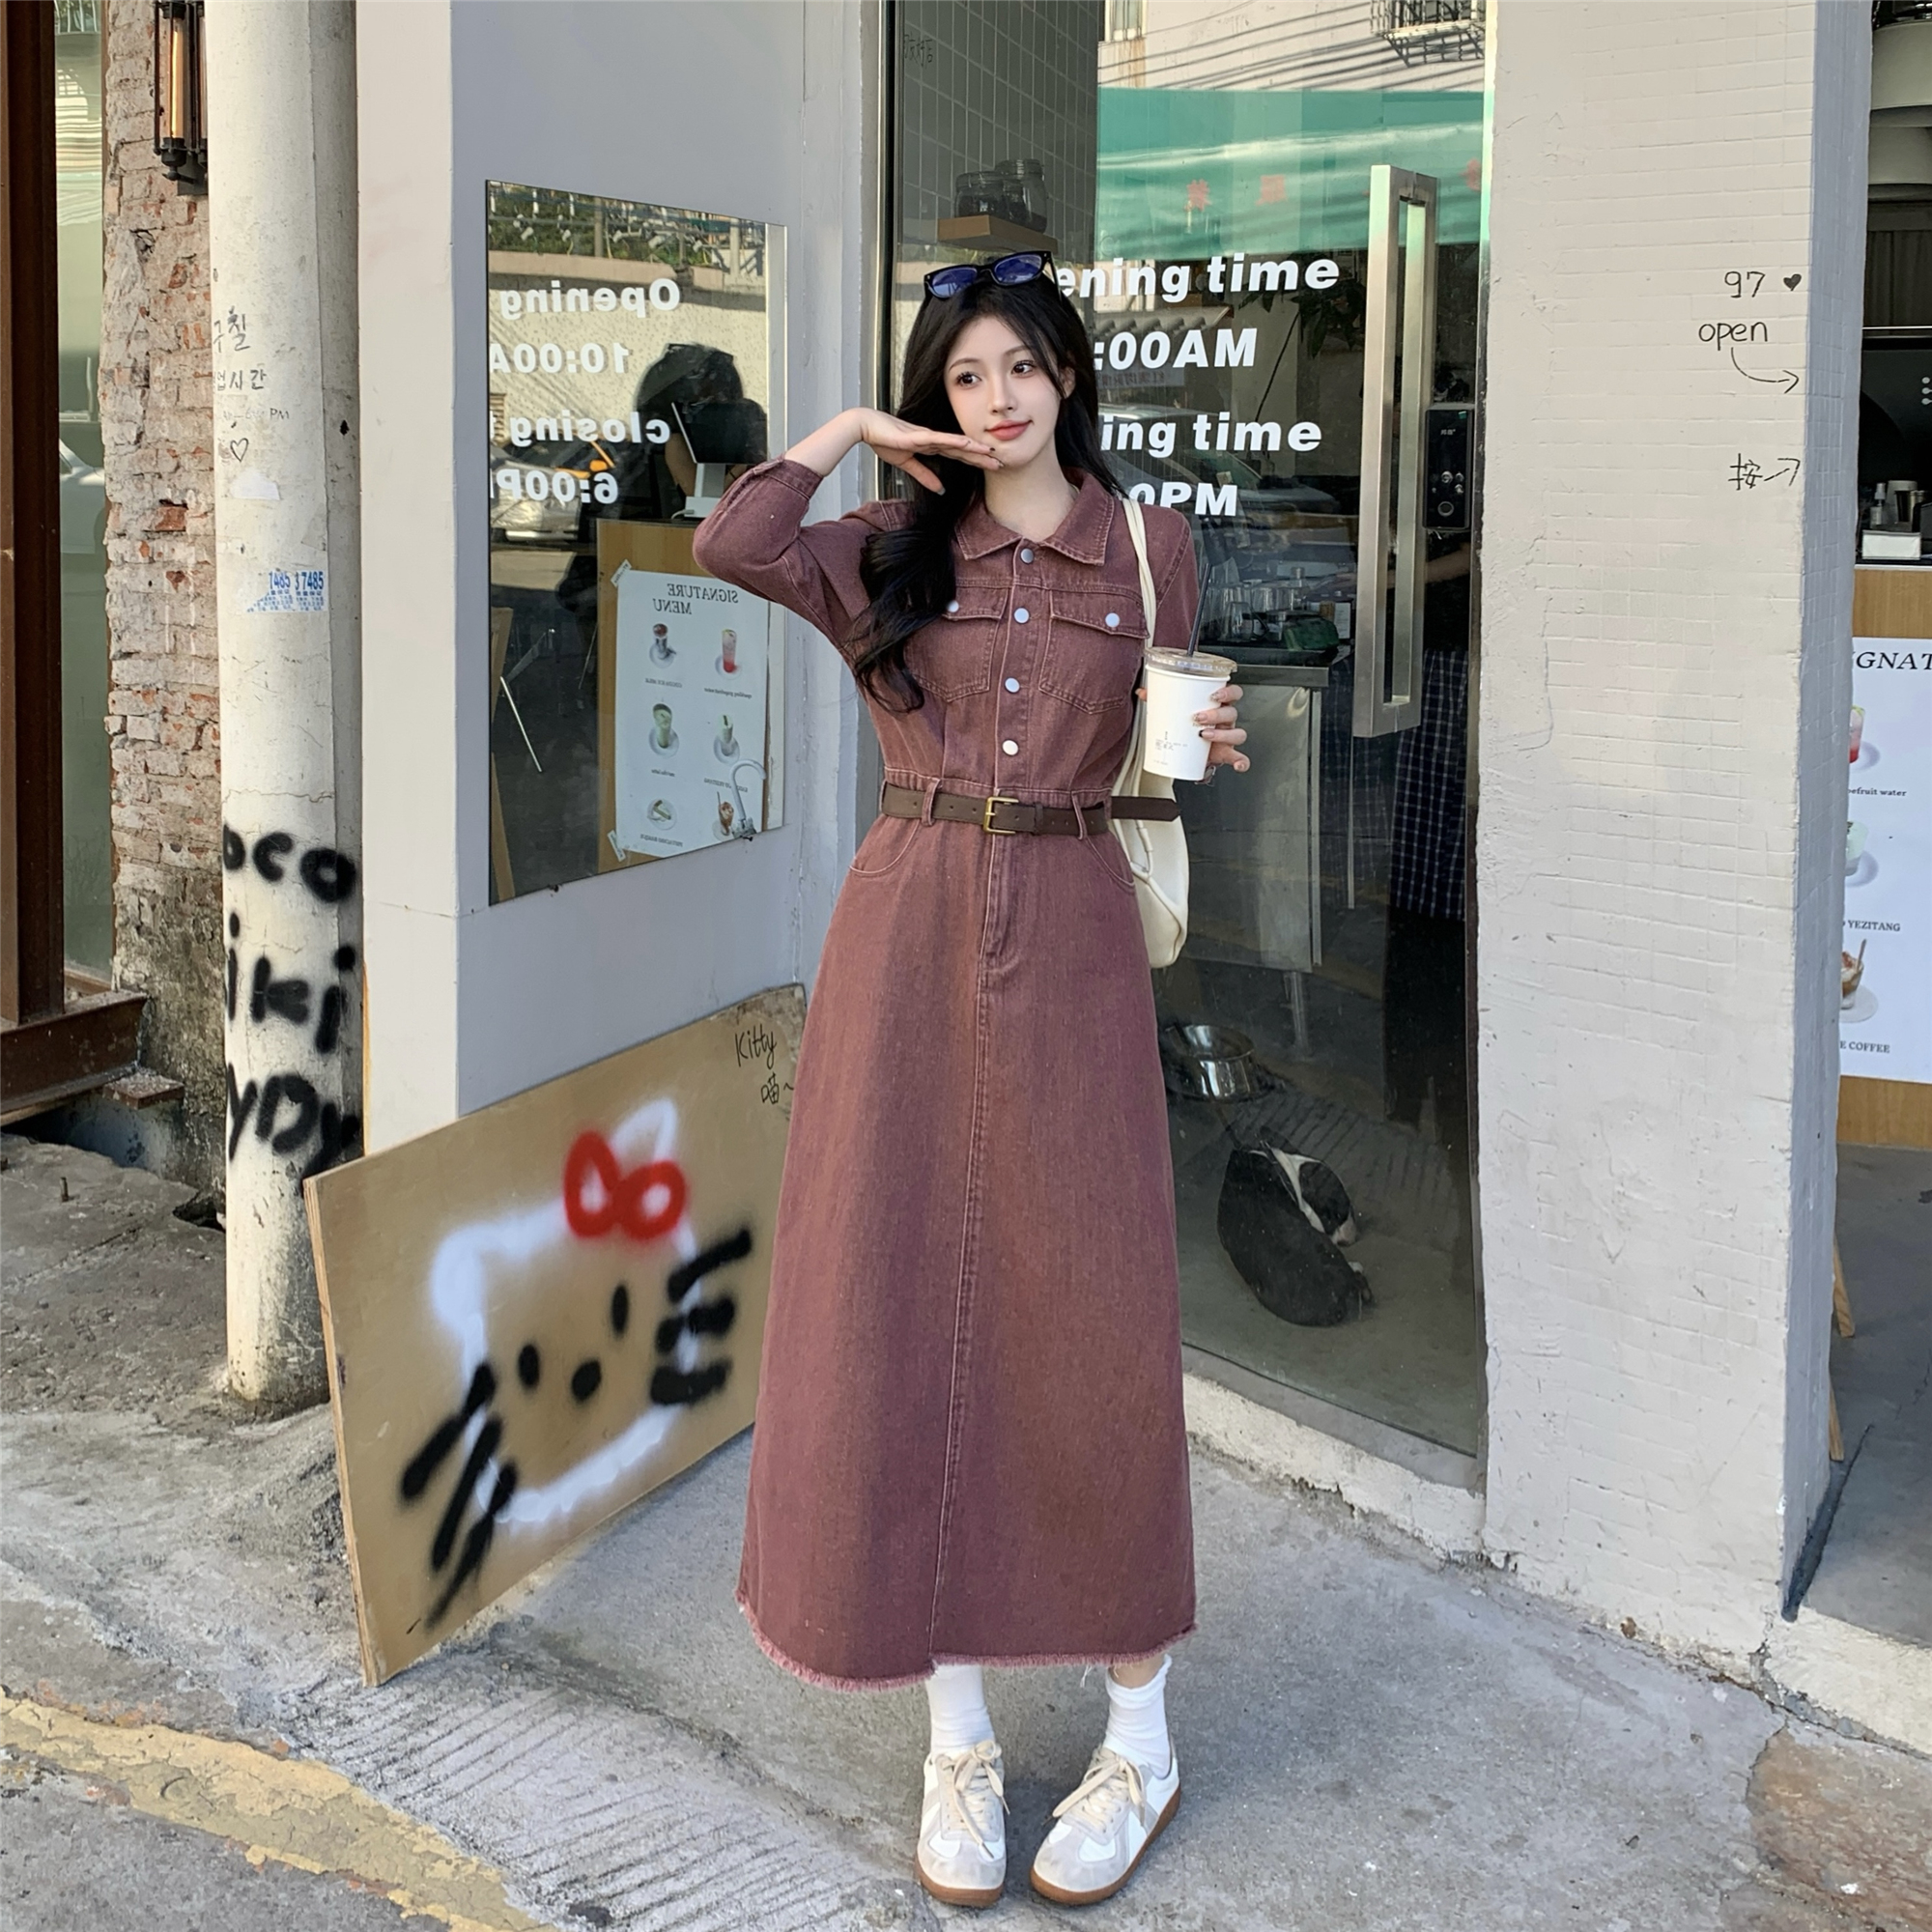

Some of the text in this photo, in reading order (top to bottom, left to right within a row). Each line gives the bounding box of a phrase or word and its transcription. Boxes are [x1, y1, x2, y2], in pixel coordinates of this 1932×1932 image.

[1208, 252, 1340, 293] time
[1724, 270, 1766, 298] 97
[1698, 322, 1768, 352] open
[213, 368, 267, 391] 업시간
[1193, 412, 1321, 451] time
[1853, 651, 1932, 670] GNAT
[1847, 919, 1901, 932] YEZITANG
[735, 1023, 778, 1069] Kitty
[1848, 1040, 1891, 1054] COFFEE
